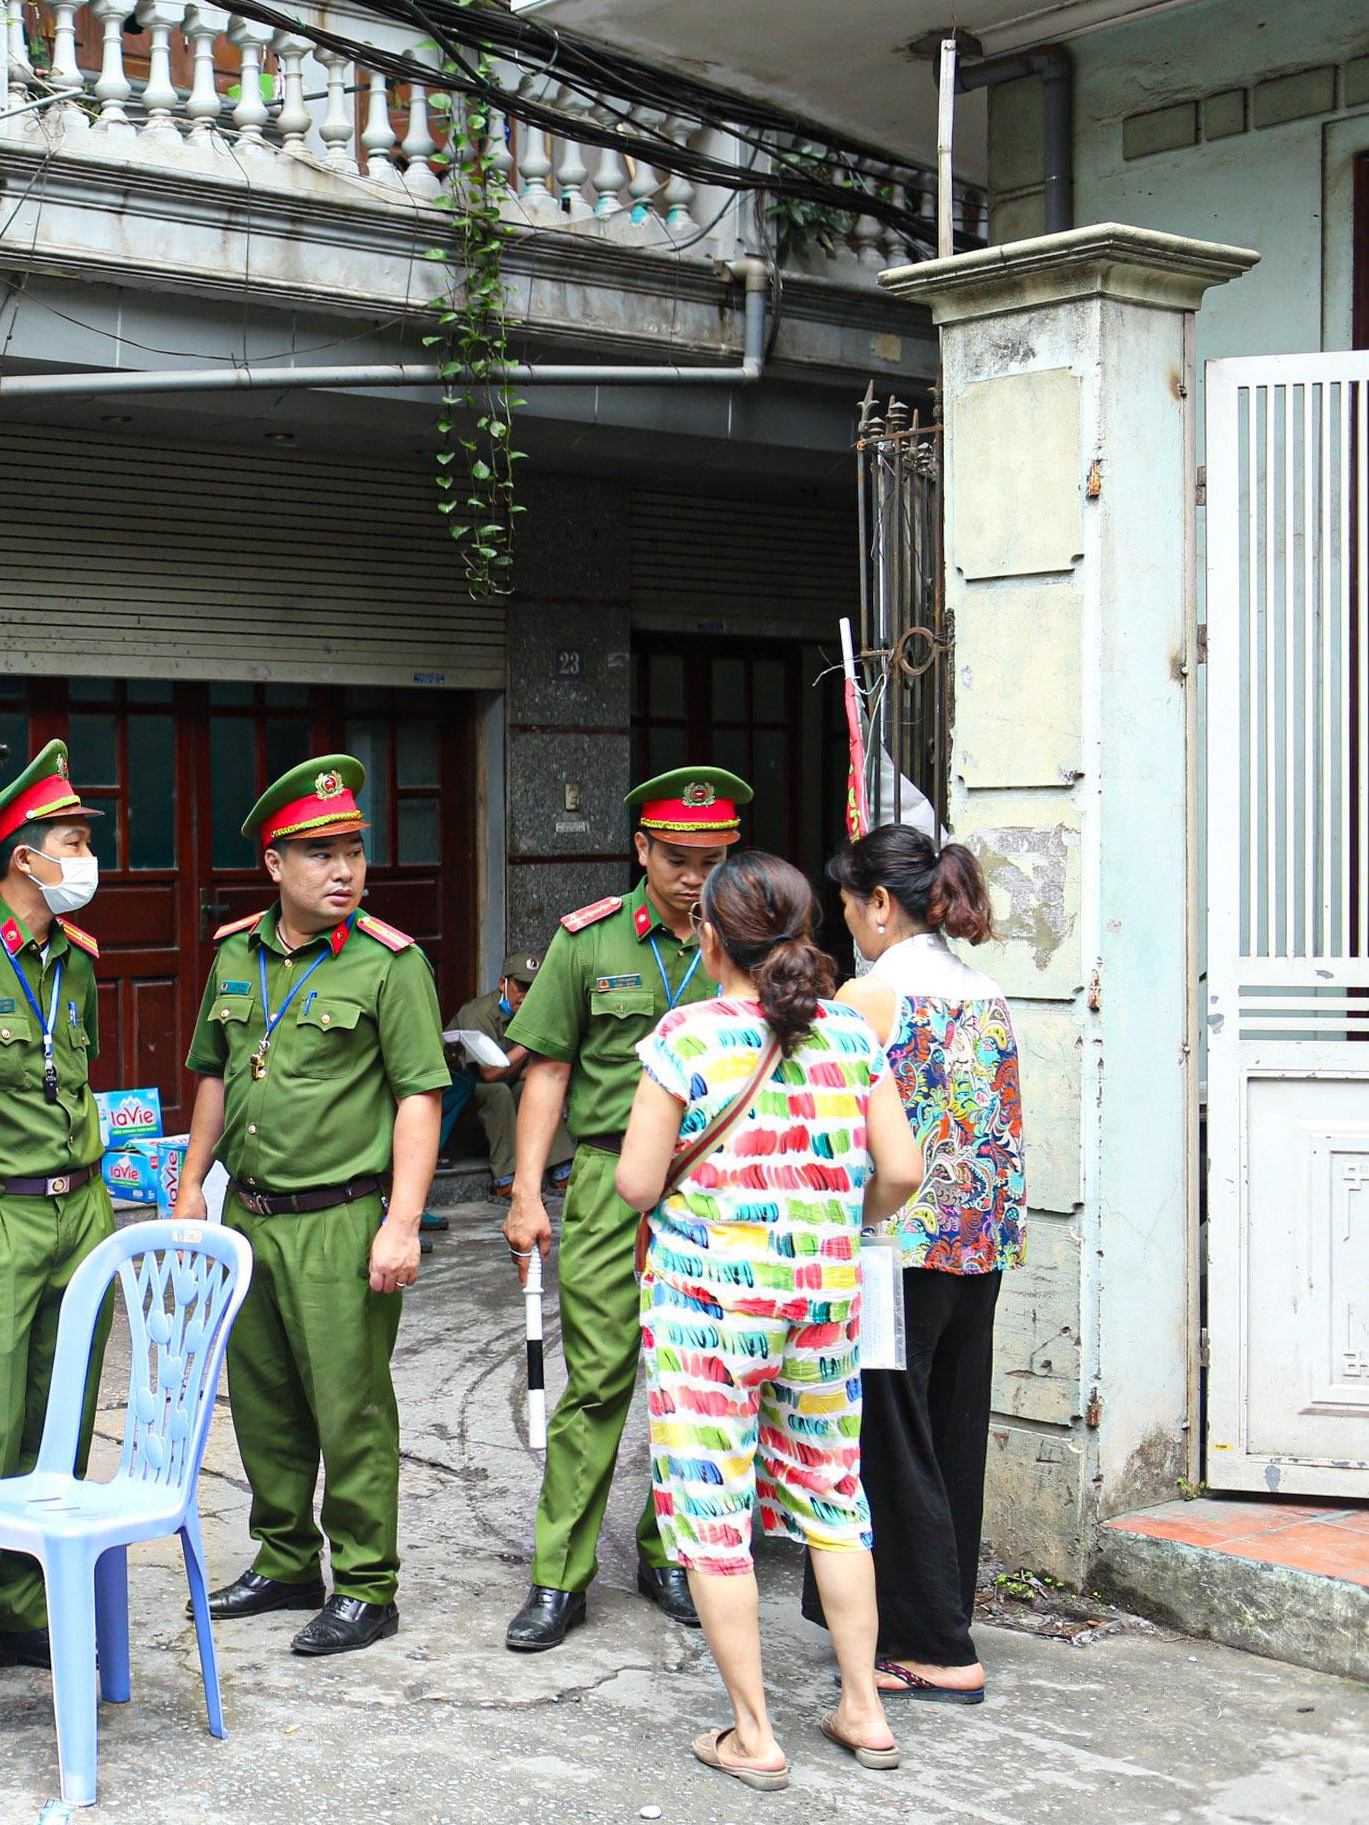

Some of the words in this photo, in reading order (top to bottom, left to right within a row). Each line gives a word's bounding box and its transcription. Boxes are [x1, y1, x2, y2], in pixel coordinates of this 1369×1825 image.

[559, 652, 580, 674] 23
[110, 1105, 154, 1126] laVie
[109, 1165, 139, 1181] laVie
[165, 1151, 179, 1208] laVie
